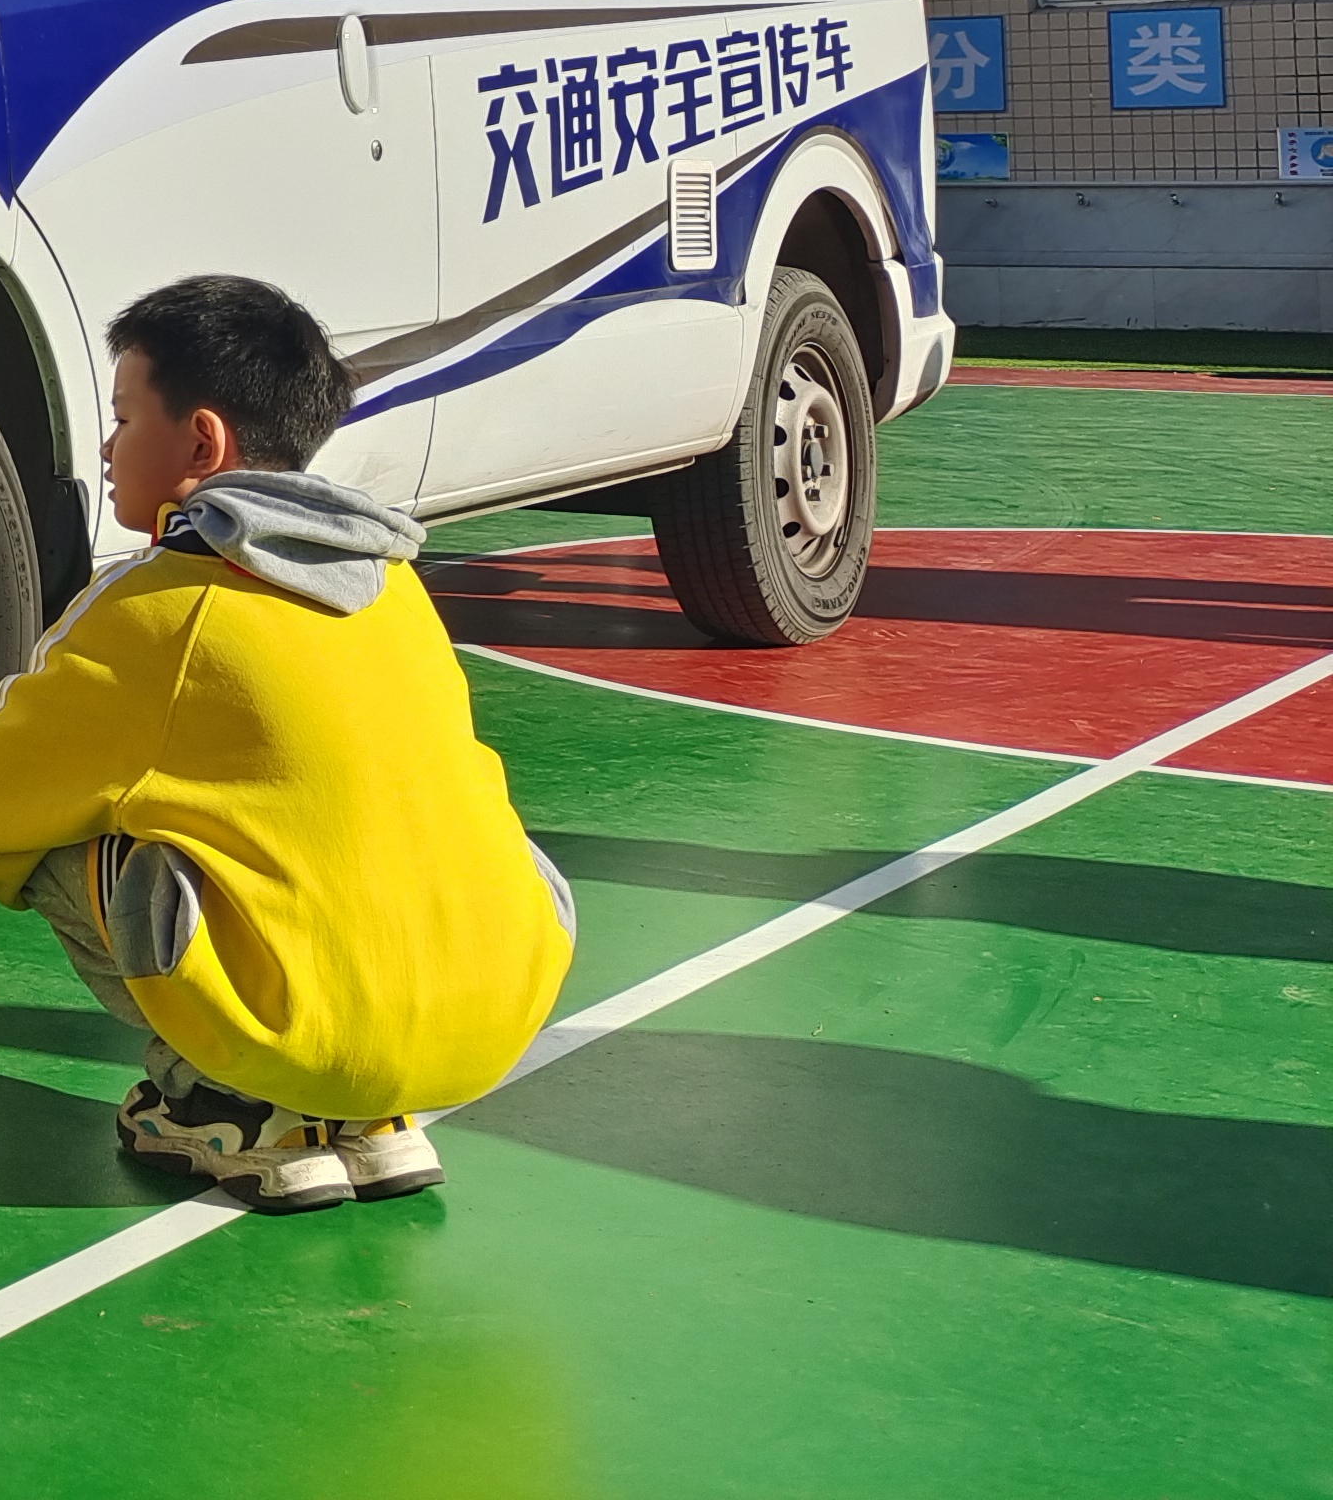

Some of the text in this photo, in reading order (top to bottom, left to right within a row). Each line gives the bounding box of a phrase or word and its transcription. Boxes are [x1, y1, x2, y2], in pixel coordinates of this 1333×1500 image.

[477, 18, 854, 224] 交通安全宣传车
[931, 22, 1207, 99] 分 类
